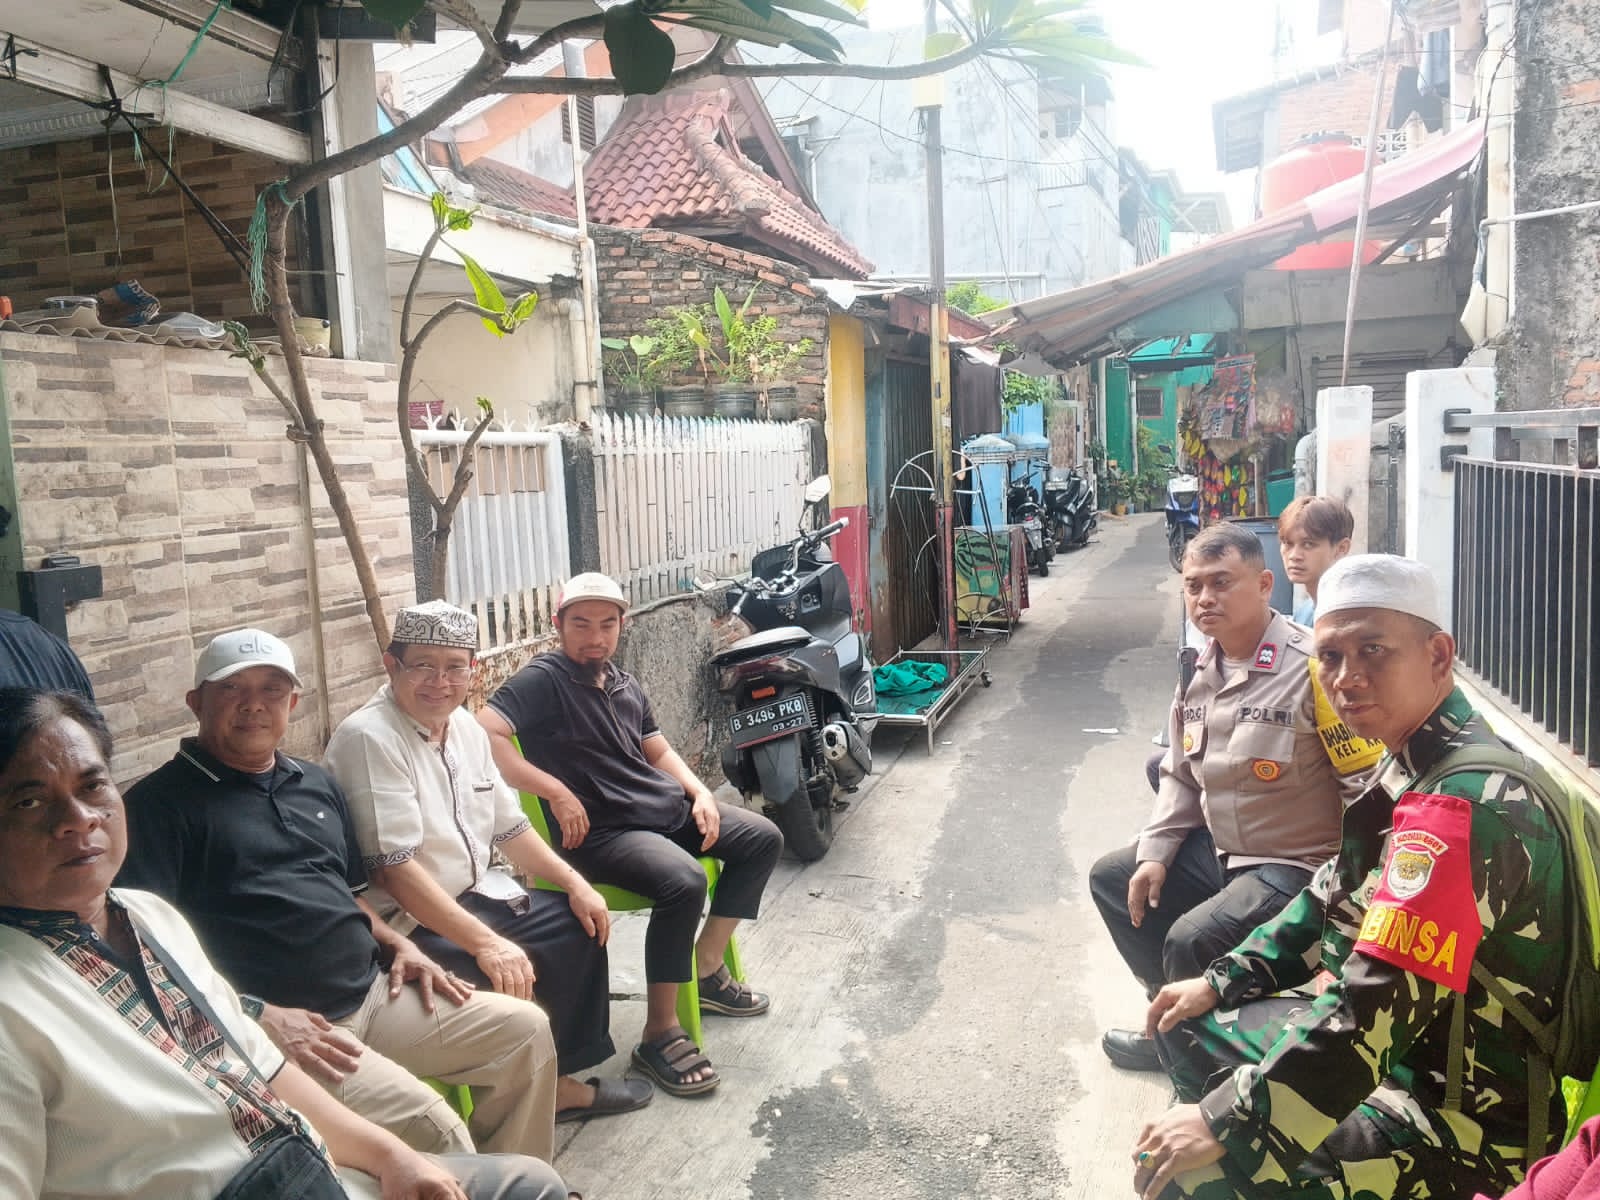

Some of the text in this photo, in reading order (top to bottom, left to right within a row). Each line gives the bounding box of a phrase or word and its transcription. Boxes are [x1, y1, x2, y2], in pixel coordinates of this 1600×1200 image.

[733, 718, 742, 732] B
[746, 710, 775, 726] 3496
[1240, 706, 1292, 724] POLRI
[1334, 742, 1361, 760] KEL.
